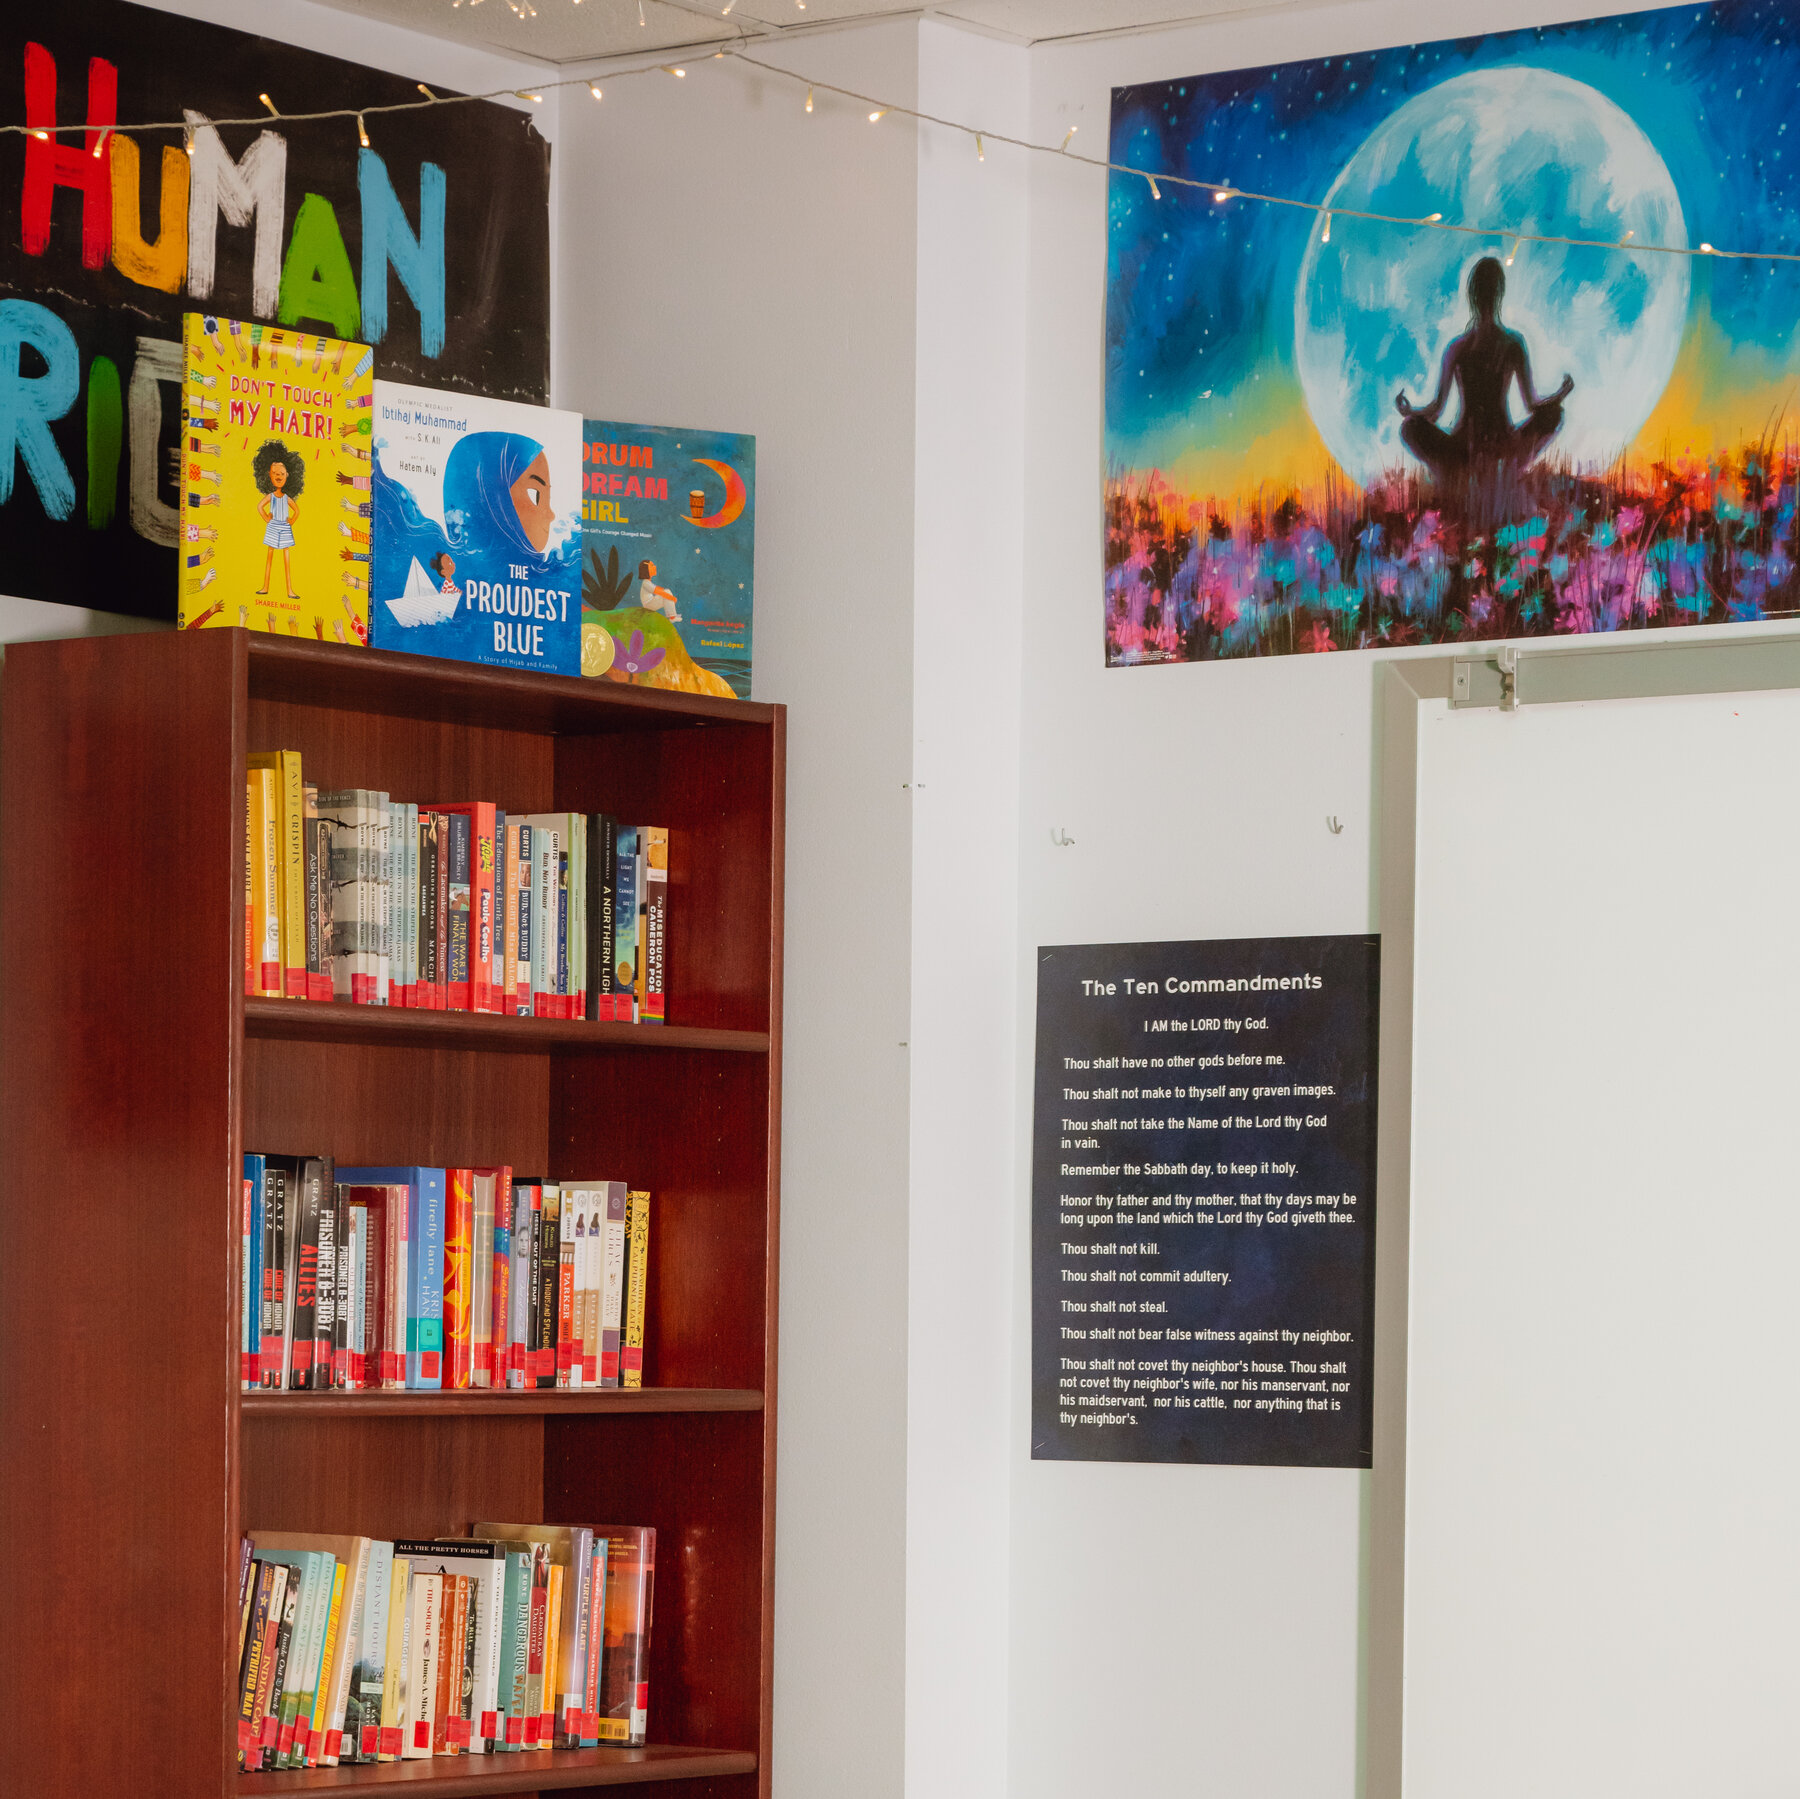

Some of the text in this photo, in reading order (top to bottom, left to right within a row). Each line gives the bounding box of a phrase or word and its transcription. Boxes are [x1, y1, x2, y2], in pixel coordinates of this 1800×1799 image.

[22, 41, 446, 358] HUMAN
[230, 374, 333, 409] DON'T TOUCH
[229, 398, 333, 440] MY HAIR!
[382, 406, 467, 431] Ibtihaj Muhammad
[399, 460, 436, 476] Hatem Aly
[508, 564, 528, 580] THE
[255, 600, 301, 612] SHAREE MILLER
[466, 580, 571, 622] PROUDEST
[494, 621, 544, 656] BLUE
[484, 656, 499, 664] Story
[509, 659, 524, 667] Hijab
[539, 662, 558, 671] Family
[292, 814, 300, 864] CRISPIN
[310, 875, 318, 892] Me
[604, 886, 611, 894] A
[310, 893, 318, 908] No
[310, 910, 318, 962] Questions
[482, 888, 491, 963] Paulo Coelho
[602, 899, 611, 964] NORTHERN
[649, 906, 657, 964] CAMERON
[655, 910, 663, 994] MISEDUCATION
[1082, 973, 1322, 996] The Ten Commandments
[1144, 1018, 1268, 1033] I AM the LORD thy God.
[1063, 1084, 1336, 1101] Thou shalt not make to thyself any graven images.
[1062, 1115, 1326, 1131] Thou shalt not take the Name of the Lord thy God
[1061, 1137, 1100, 1148] in vain.
[1060, 1193, 1356, 1209] Honor thy father and thy mother, that thy days may be
[1060, 1211, 1355, 1227] long upon the land which the Lord thy God giveth thee.
[298, 1178, 319, 1307] GRATZ ALLIES
[427, 1197, 438, 1276] firefly lane
[533, 1259, 538, 1270] OF
[1060, 1358, 1346, 1375] Thou shalt not covet thy neighbor's house. Thou shalt
[1060, 1376, 1350, 1392] not covet thy neighbor's wife, nor his manservant, nor
[1060, 1394, 1340, 1413] his maidservant, nor his cattle, nor anything that is
[1060, 1412, 1138, 1427] thy neighbor's.
[460, 1547, 489, 1555] HORSES
[582, 1576, 590, 1618] PURPLE
[515, 1603, 528, 1672] DANGEROUS
[531, 1608, 539, 1654] DAUGHTER
[242, 1639, 262, 1716] PETRIFIED MAN
